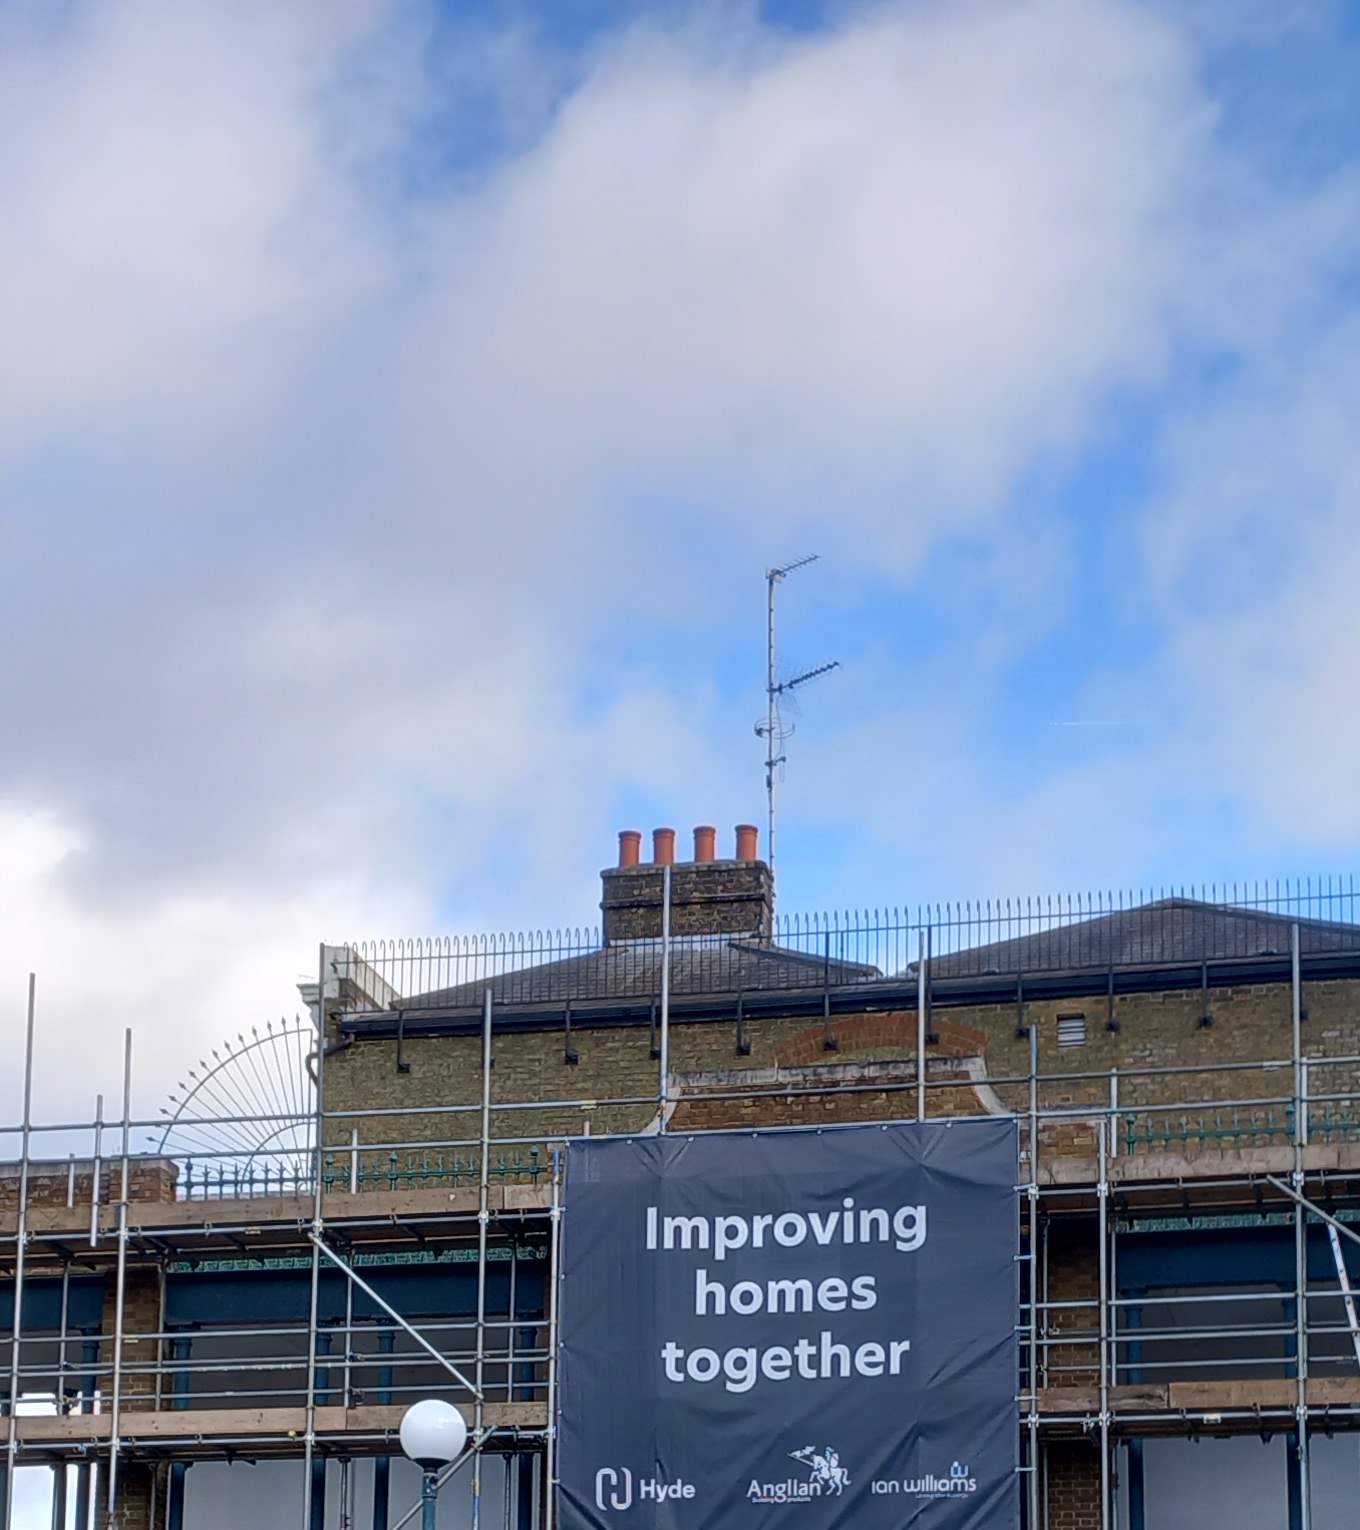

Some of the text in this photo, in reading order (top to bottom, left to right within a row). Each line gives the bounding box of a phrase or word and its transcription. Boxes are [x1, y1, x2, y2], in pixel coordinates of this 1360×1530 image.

[645, 1197, 928, 1261] Improving
[694, 1269, 878, 1316] homes
[660, 1331, 911, 1393] together
[639, 1478, 696, 1502] Hyde
[746, 1477, 822, 1503] Anglian
[903, 1474, 978, 1494] williams
